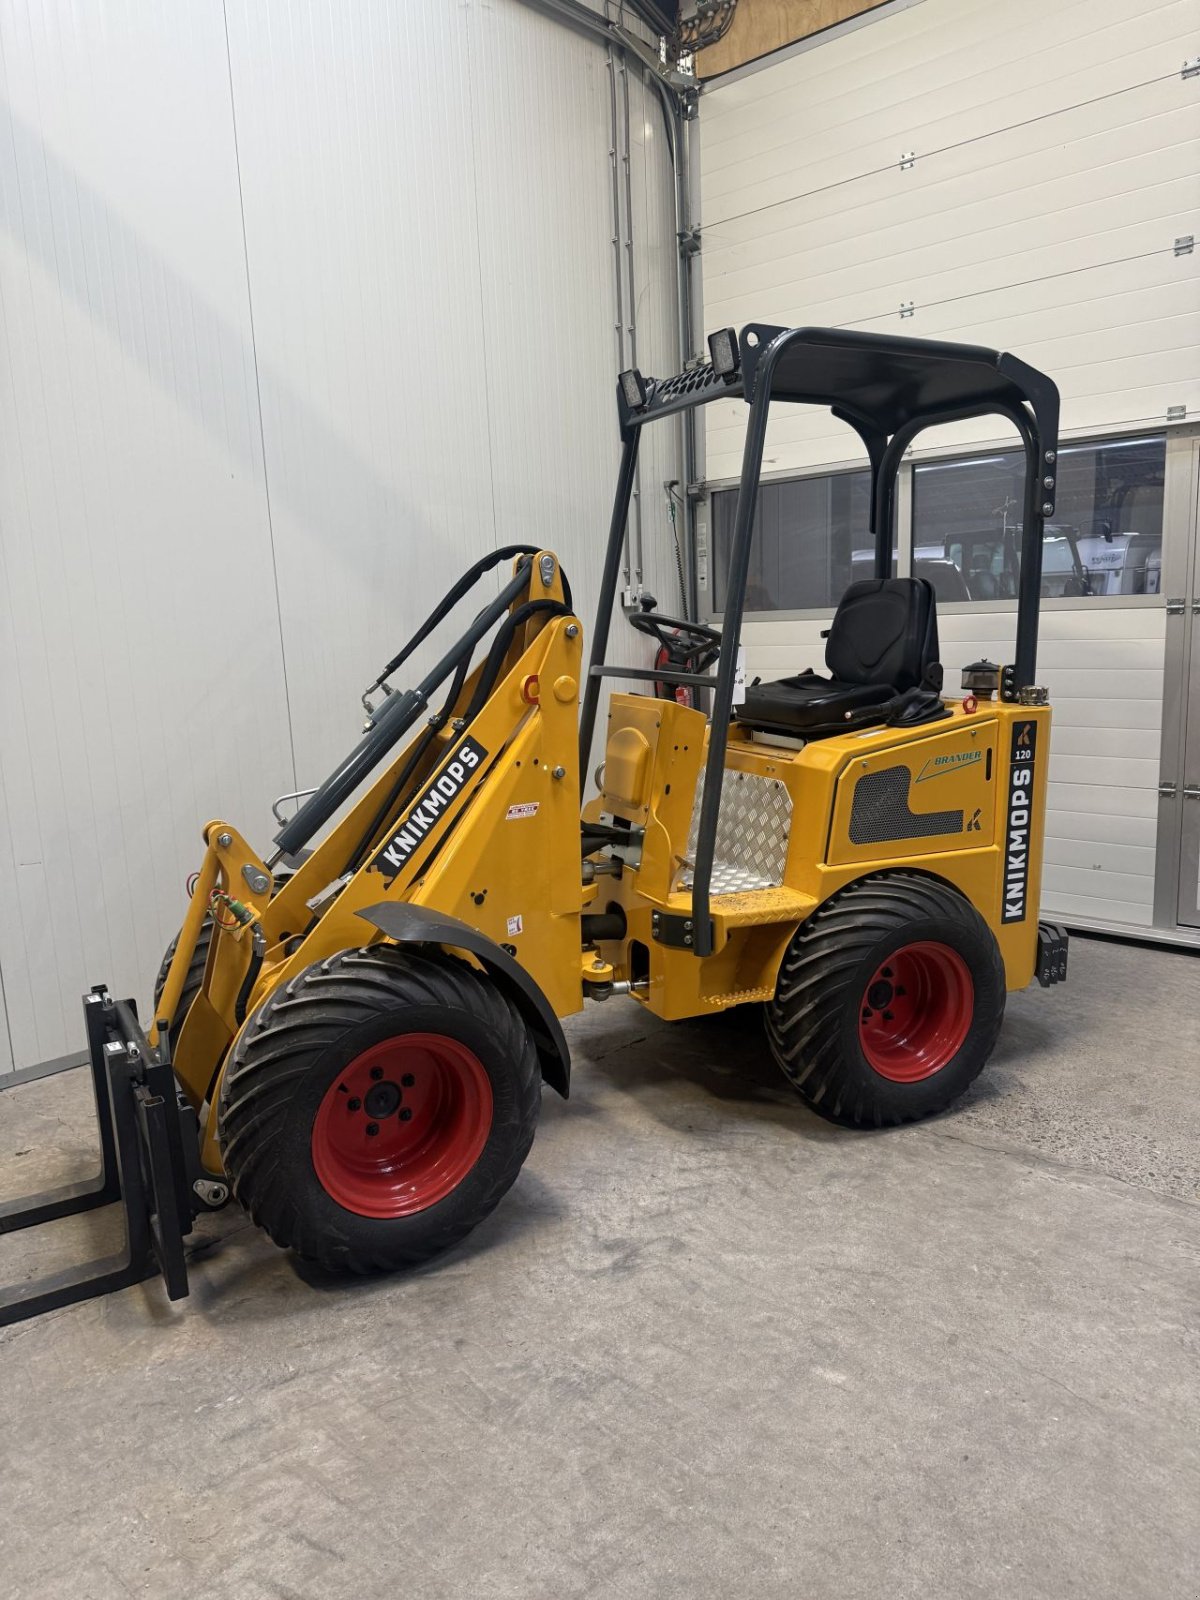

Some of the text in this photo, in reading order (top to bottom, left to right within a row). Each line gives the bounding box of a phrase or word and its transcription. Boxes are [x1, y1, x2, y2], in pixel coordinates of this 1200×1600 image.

[935, 751, 982, 765] BRANDER
[1015, 750, 1031, 760] 120
[383, 746, 479, 867] KNIKMOPS
[1005, 769, 1031, 918] KNIKMOPS
